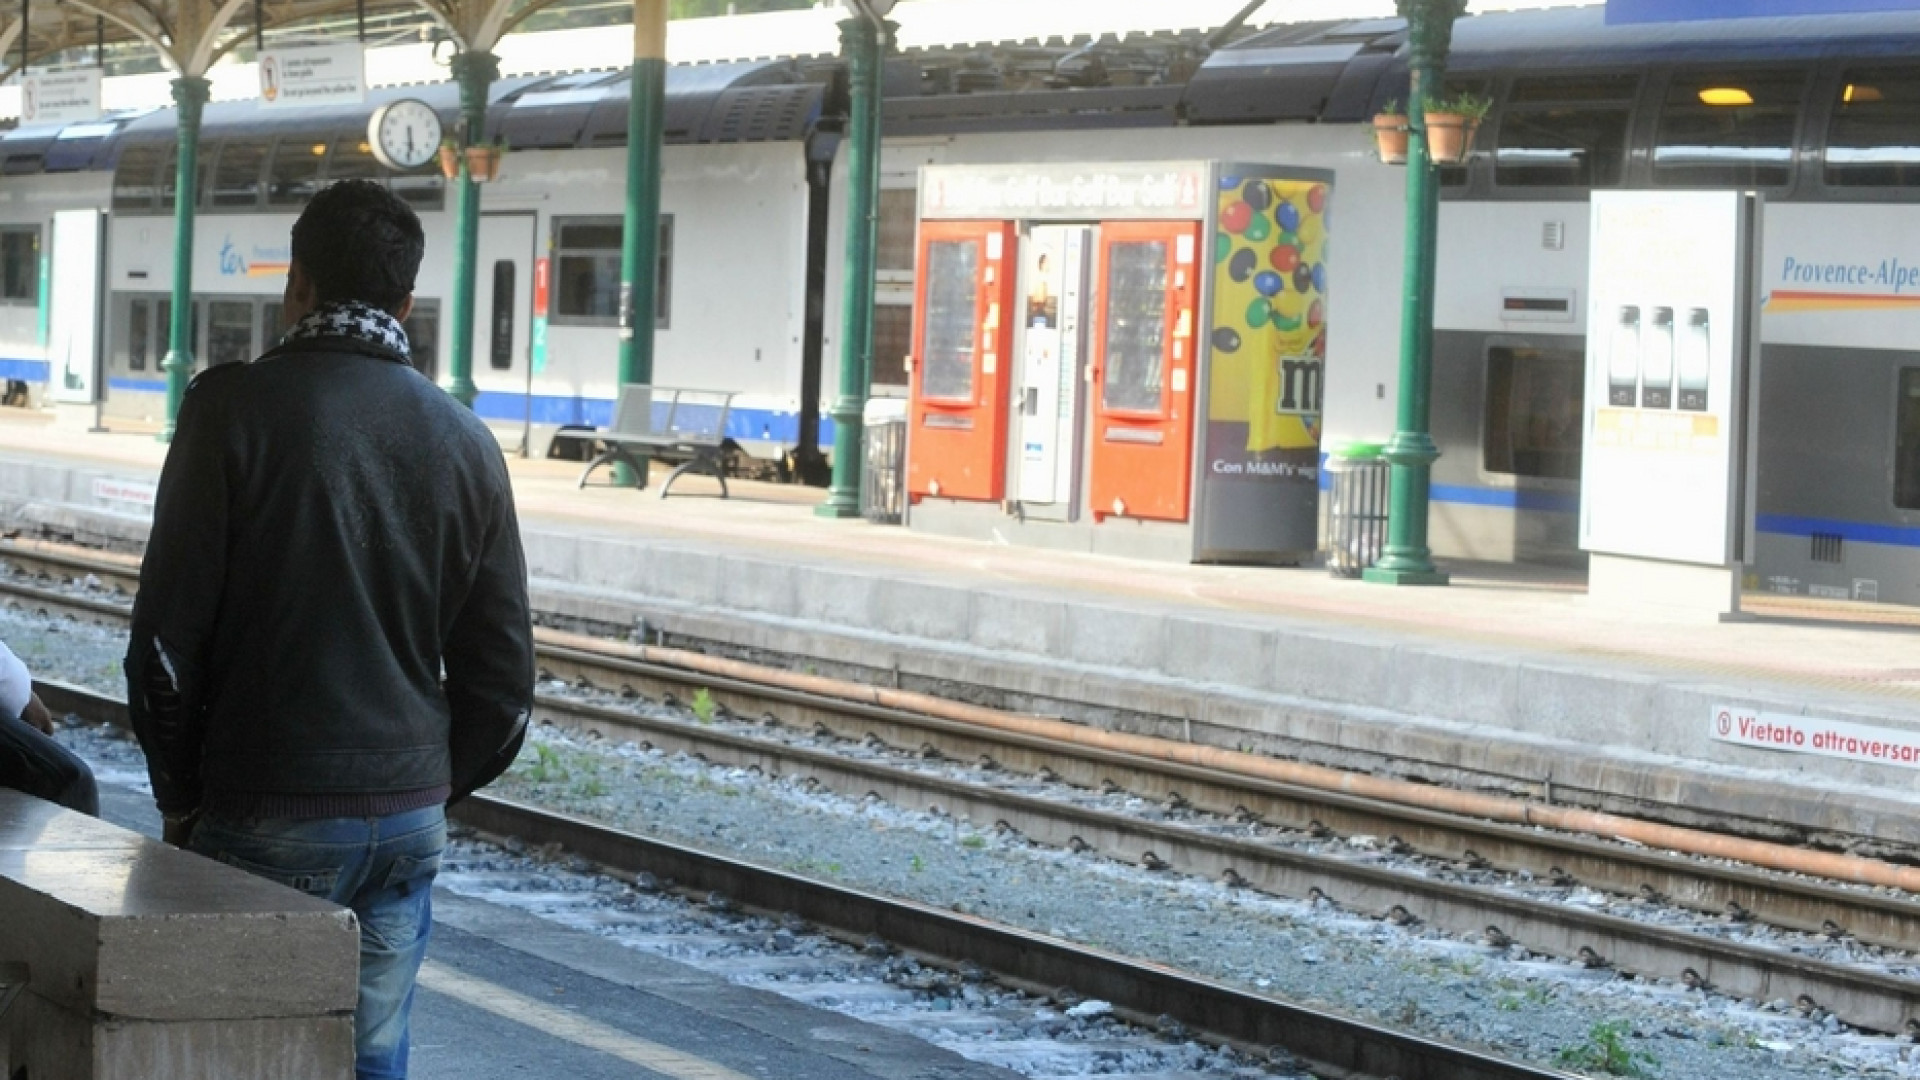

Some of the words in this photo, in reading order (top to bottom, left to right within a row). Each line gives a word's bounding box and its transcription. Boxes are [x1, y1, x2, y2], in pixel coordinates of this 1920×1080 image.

[1141, 172, 1178, 207] Self
[1782, 256, 1920, 294] Provence-Alpe
[1213, 459, 1242, 474] Con
[1738, 716, 1805, 745] Vietato
[1813, 730, 1920, 762] attraversar
